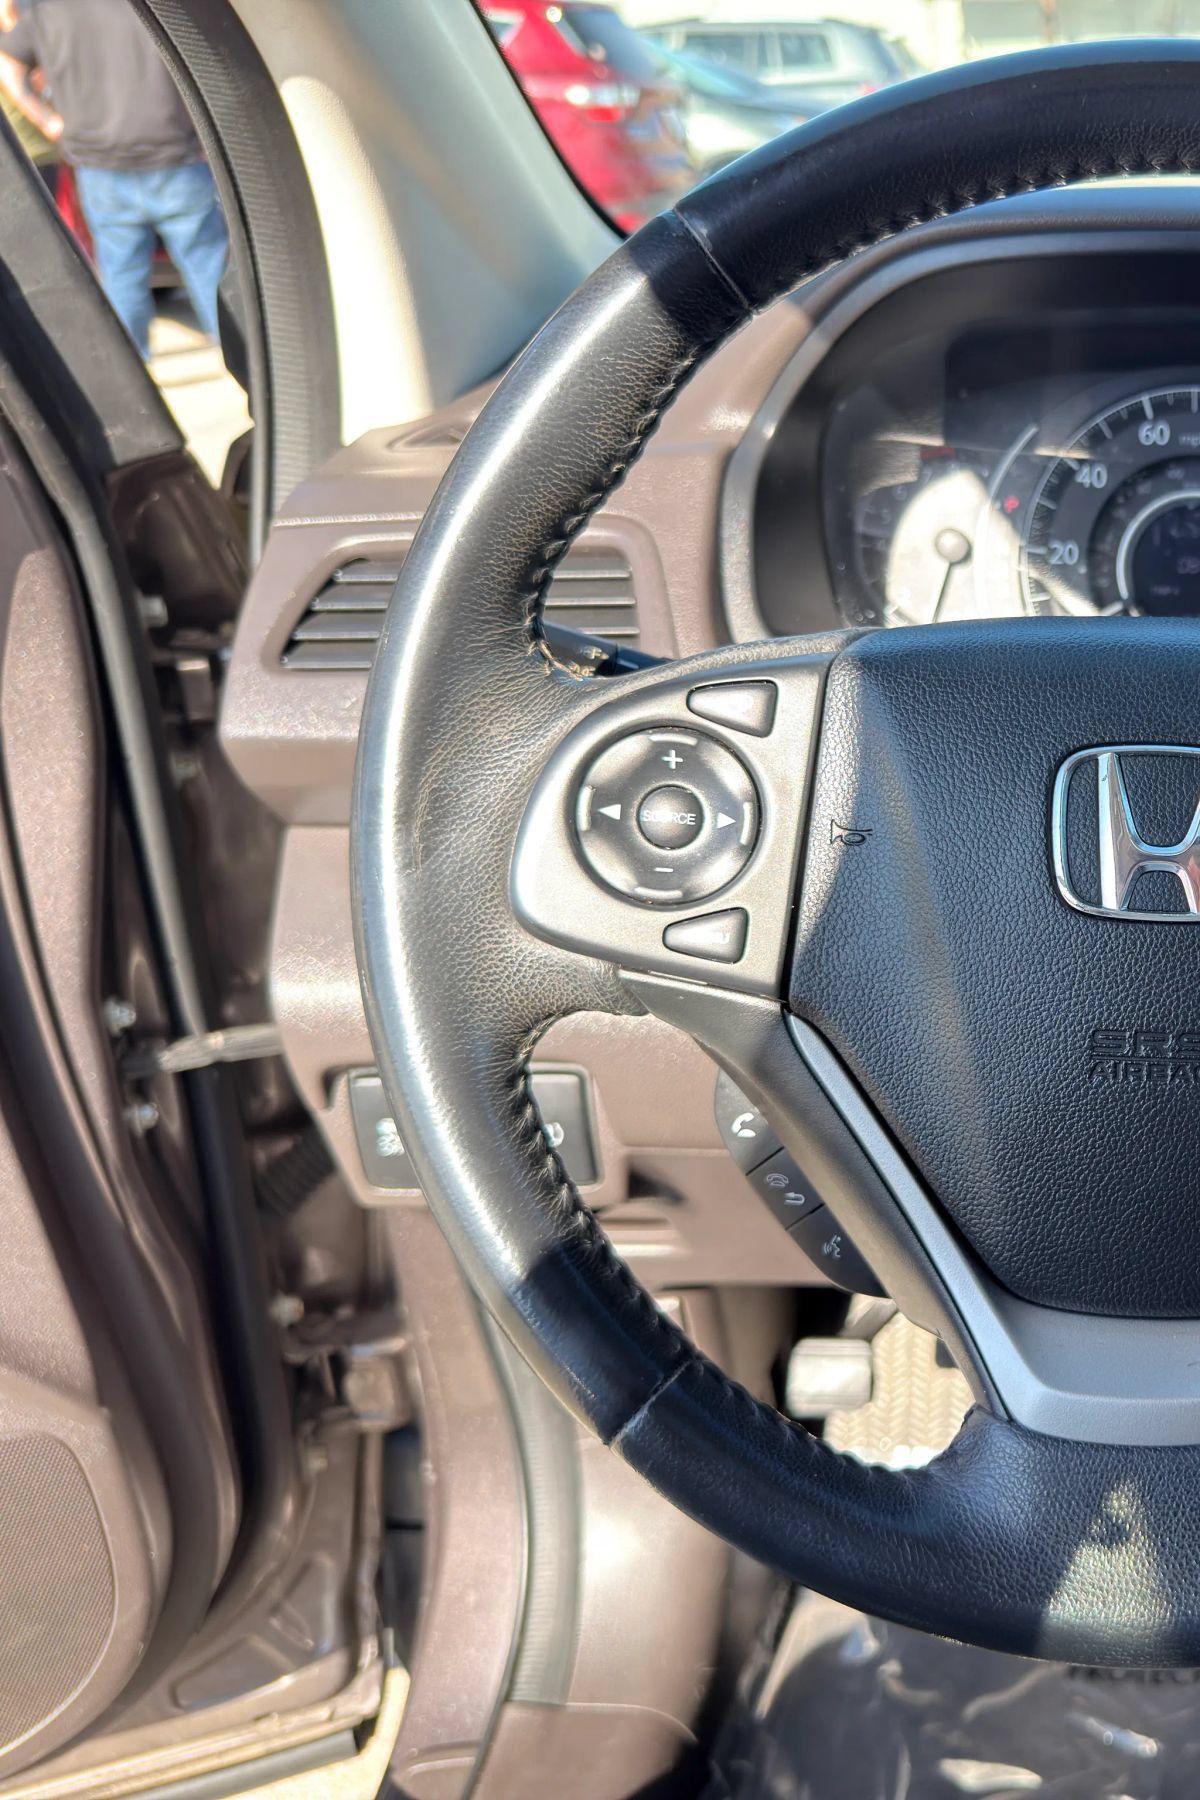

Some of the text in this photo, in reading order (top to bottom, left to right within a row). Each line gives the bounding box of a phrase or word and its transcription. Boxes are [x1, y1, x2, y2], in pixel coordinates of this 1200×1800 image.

[1138, 420, 1170, 446] 60
[1075, 462, 1108, 489] 40
[1048, 540, 1080, 566] 20
[643, 809, 696, 825] SORCE
